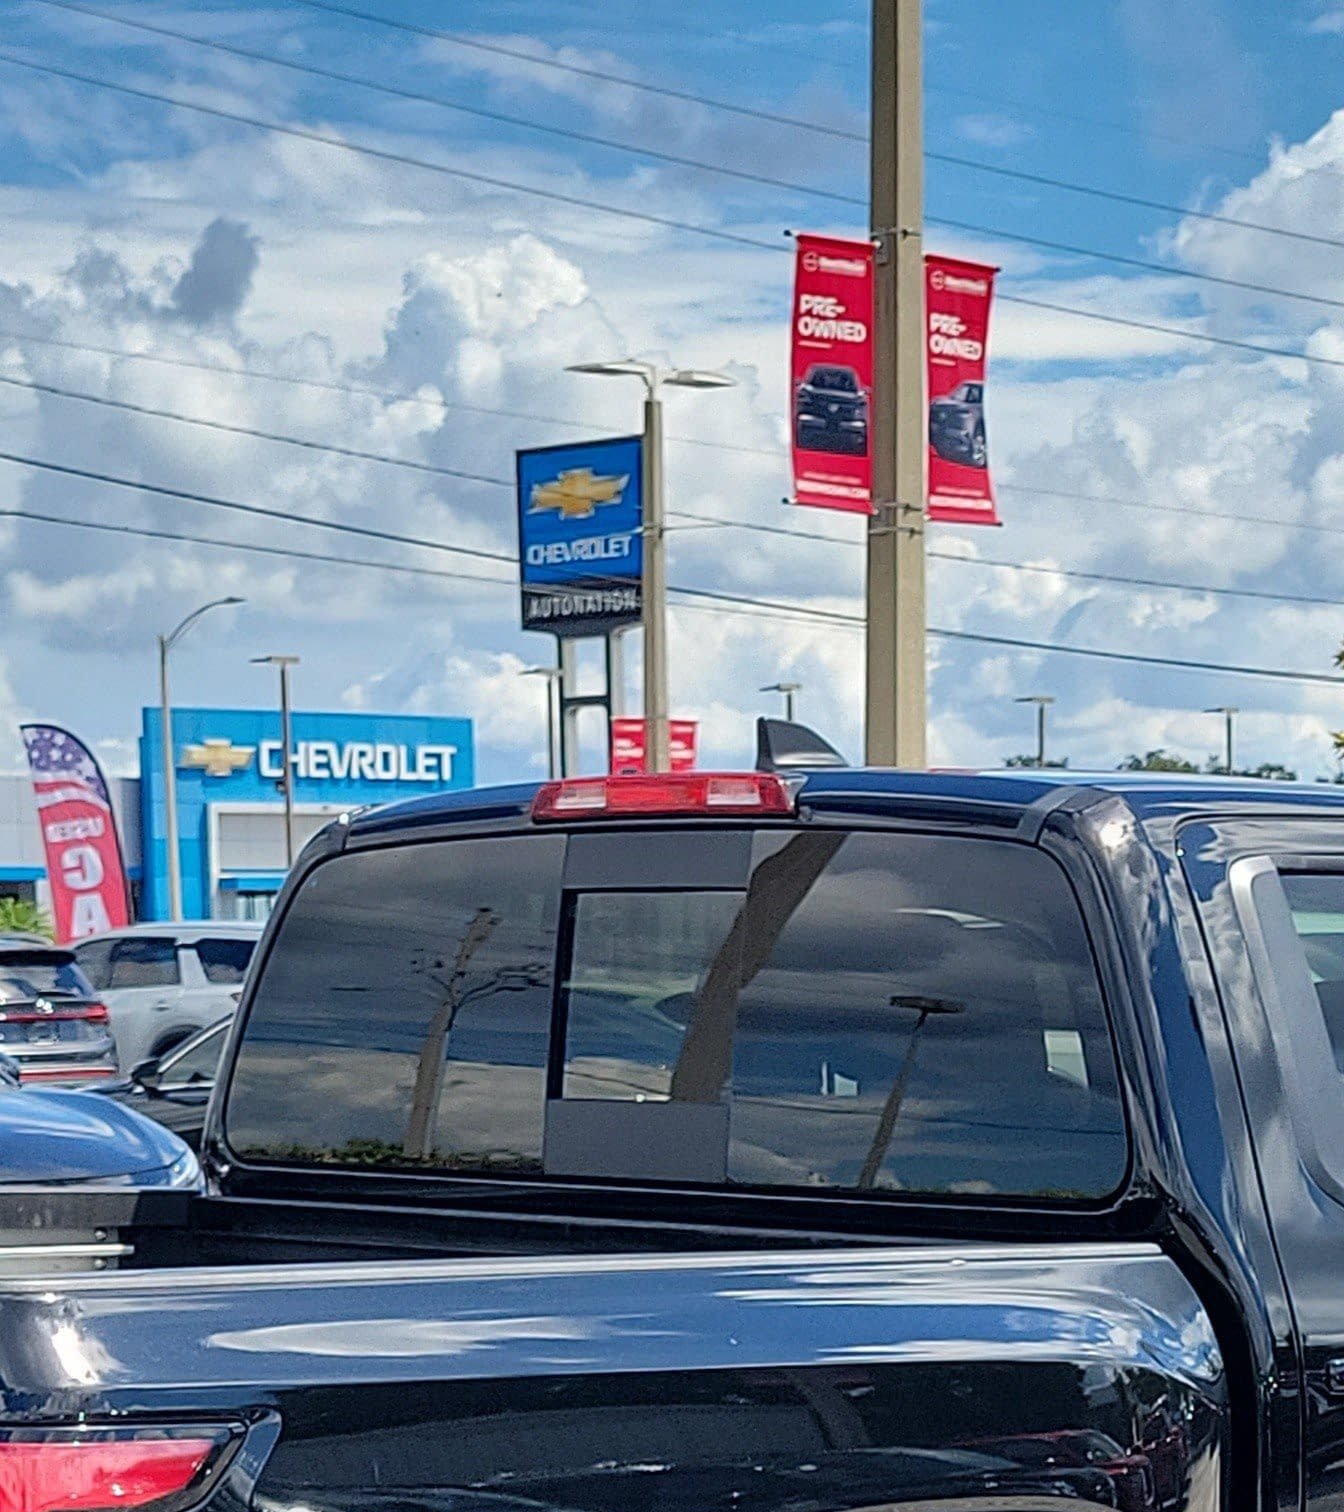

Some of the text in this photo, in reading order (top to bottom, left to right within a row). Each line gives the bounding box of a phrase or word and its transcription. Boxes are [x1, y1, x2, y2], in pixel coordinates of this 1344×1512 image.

[797, 316, 867, 343] OWNED
[929, 335, 983, 361] OWNED
[526, 535, 633, 566] CHEVROLET
[259, 740, 457, 781] CHEVROLET
